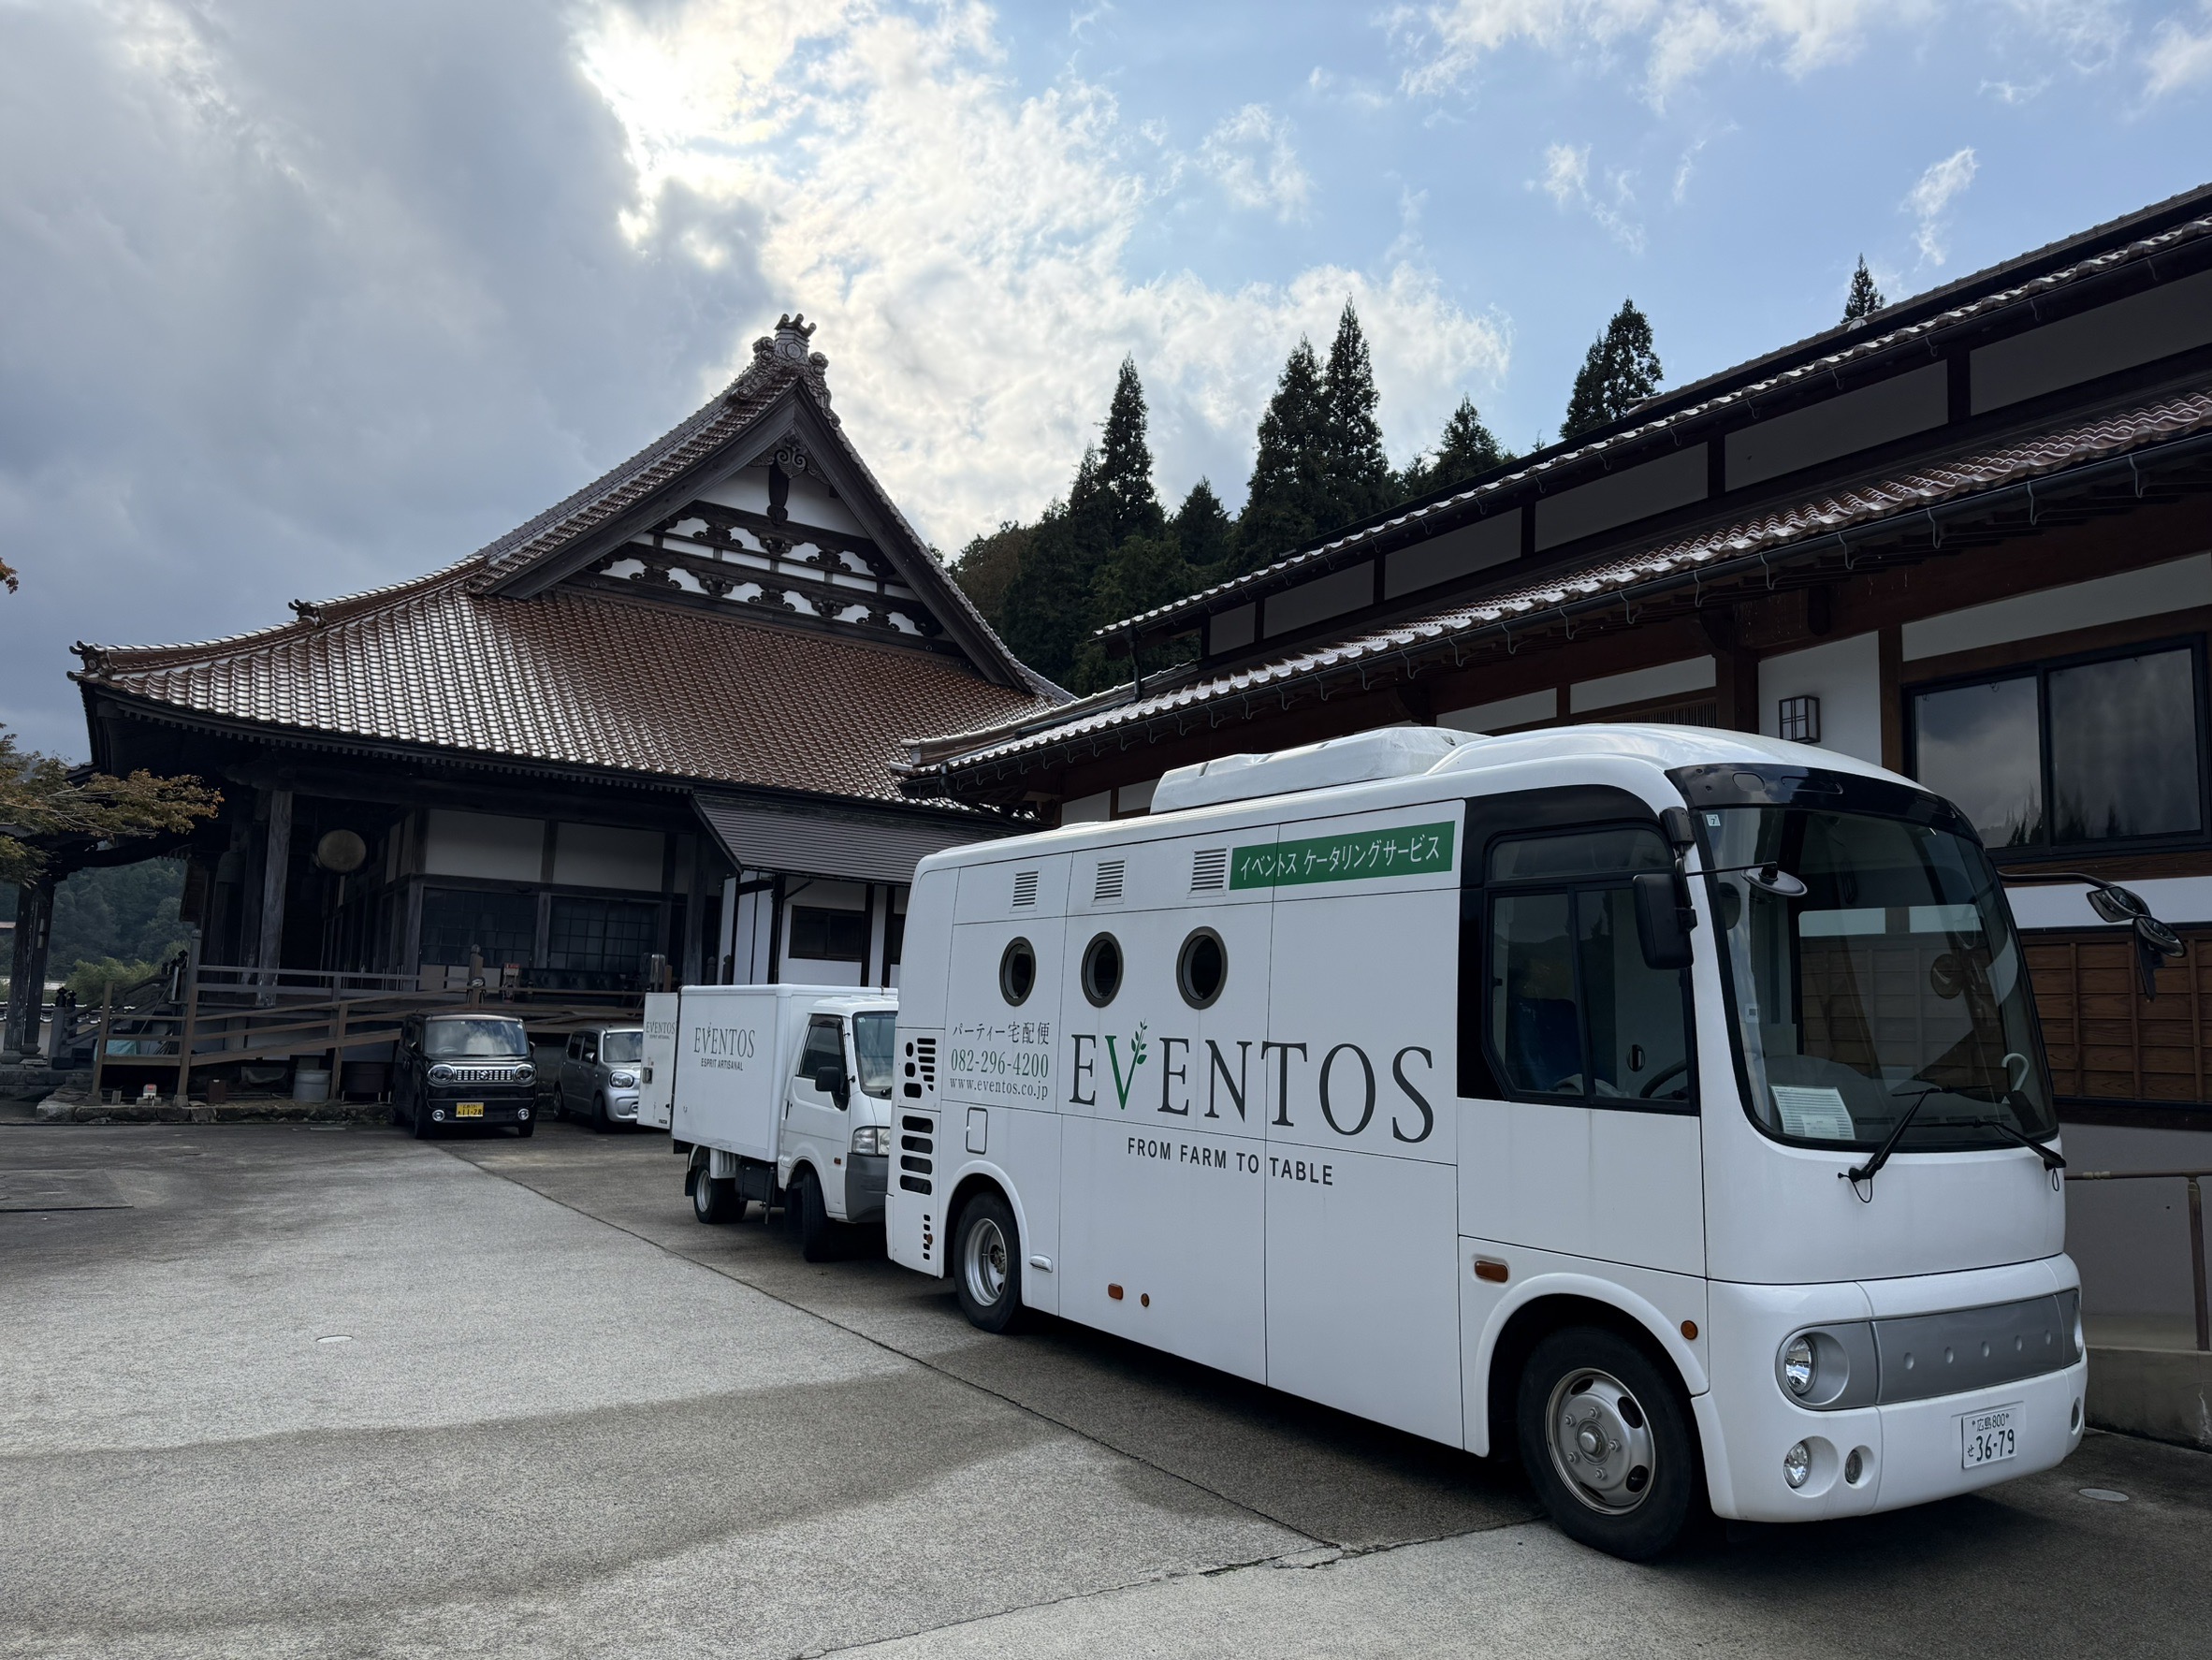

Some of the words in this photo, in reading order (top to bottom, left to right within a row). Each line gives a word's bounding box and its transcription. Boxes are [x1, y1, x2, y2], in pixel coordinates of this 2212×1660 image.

[1241, 852, 1297, 881] イベントス
[1303, 834, 1439, 876] ケータリングサービス
[646, 1021, 676, 1034] EVENTOS
[693, 1025, 755, 1058] EVENTOS
[953, 1021, 1050, 1045] パーティー宅配便
[701, 1057, 717, 1068] ESPRIT
[718, 1060, 744, 1071] ARTISANAL
[951, 1048, 1049, 1078] 082-296-4200
[950, 1077, 1048, 1100] www.eventos.co.jp
[1069, 1027, 1433, 1143] EVENTOS
[1128, 1137, 1171, 1160] FROM
[1180, 1144, 1227, 1169] FARM
[1236, 1152, 1259, 1174] TO
[1270, 1157, 1333, 1187] TABLE
